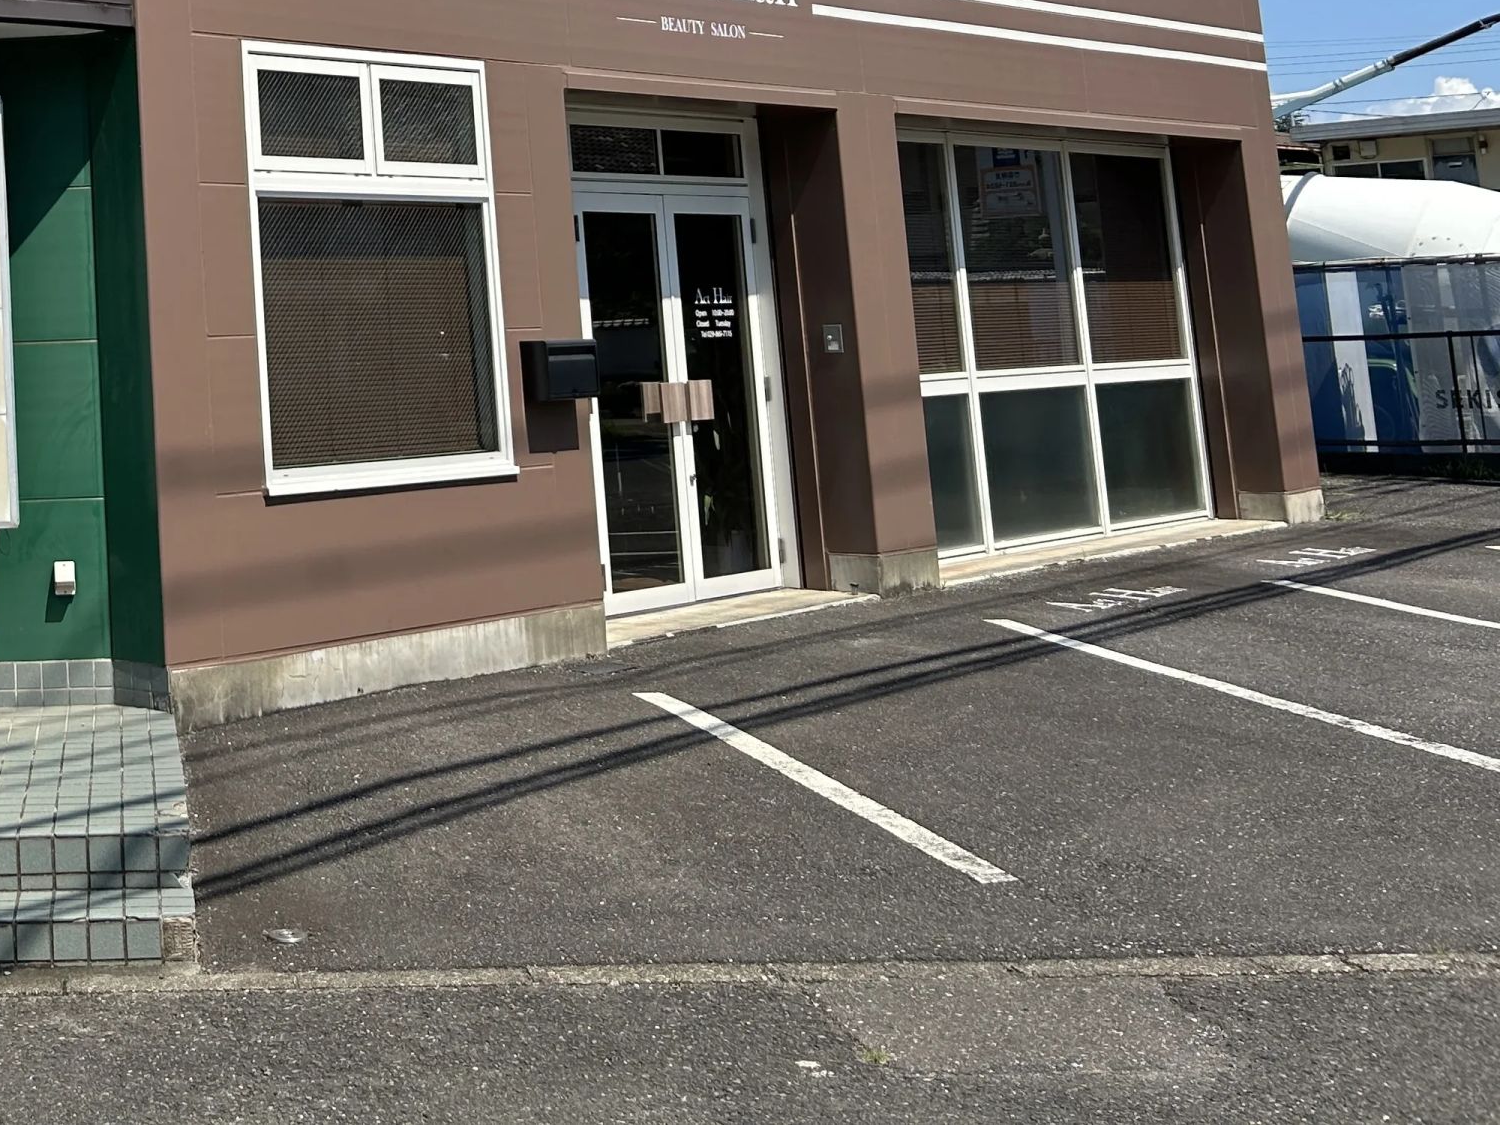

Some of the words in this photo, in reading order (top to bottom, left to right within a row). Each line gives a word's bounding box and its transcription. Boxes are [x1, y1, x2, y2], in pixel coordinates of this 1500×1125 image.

[660, 16, 705, 35] BEAUTY
[710, 22, 746, 39] SALON
[1436, 389, 1500, 409] SEKI
